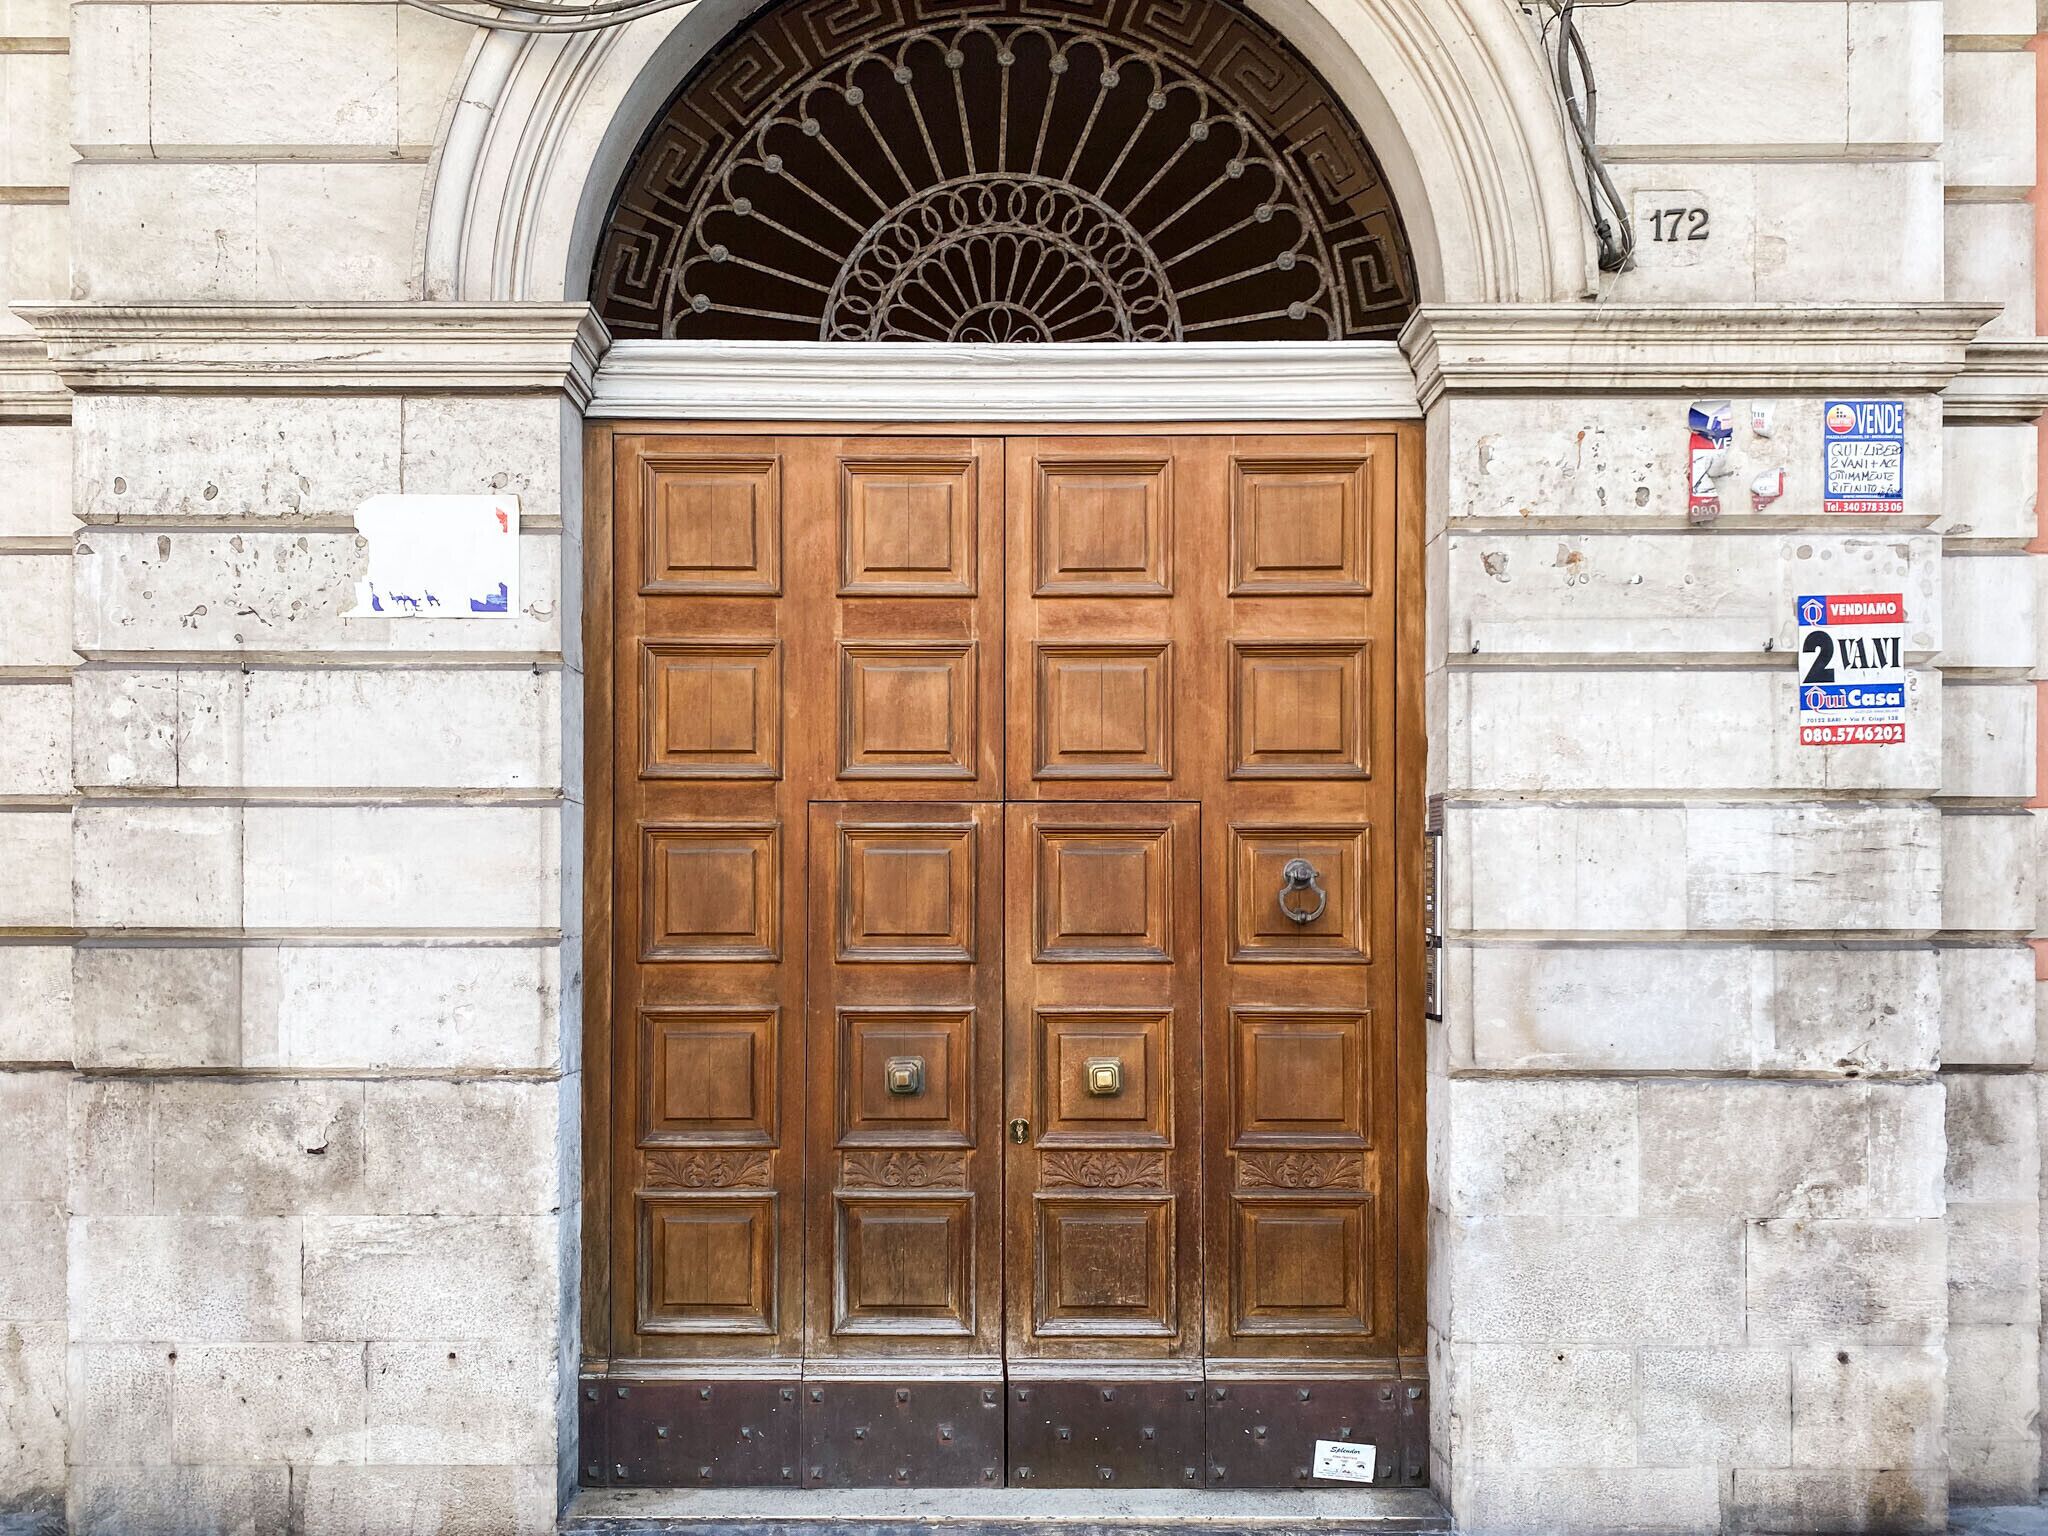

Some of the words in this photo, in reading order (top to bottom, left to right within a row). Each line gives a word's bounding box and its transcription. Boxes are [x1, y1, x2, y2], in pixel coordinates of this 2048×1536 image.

[1649, 208, 1710, 242] 172
[1856, 404, 1903, 434] VENDE
[1830, 457, 1839, 469] 2
[1841, 457, 1868, 469] VANI
[1829, 470, 1895, 481] OTTIMAMENTE
[1832, 482, 1878, 492] RIFINITO
[1827, 502, 1842, 512] Tel.
[1843, 502, 1860, 512] 340
[1861, 502, 1877, 512] 378
[1879, 502, 1890, 512] 33
[1891, 502, 1902, 512] 06
[1829, 602, 1897, 616] VENDIAMO
[1802, 630, 1835, 684] 2
[1837, 637, 1902, 670] VANI
[1802, 726, 1903, 743] 080.5746202
[1330, 1446, 1361, 1455] Splendor
